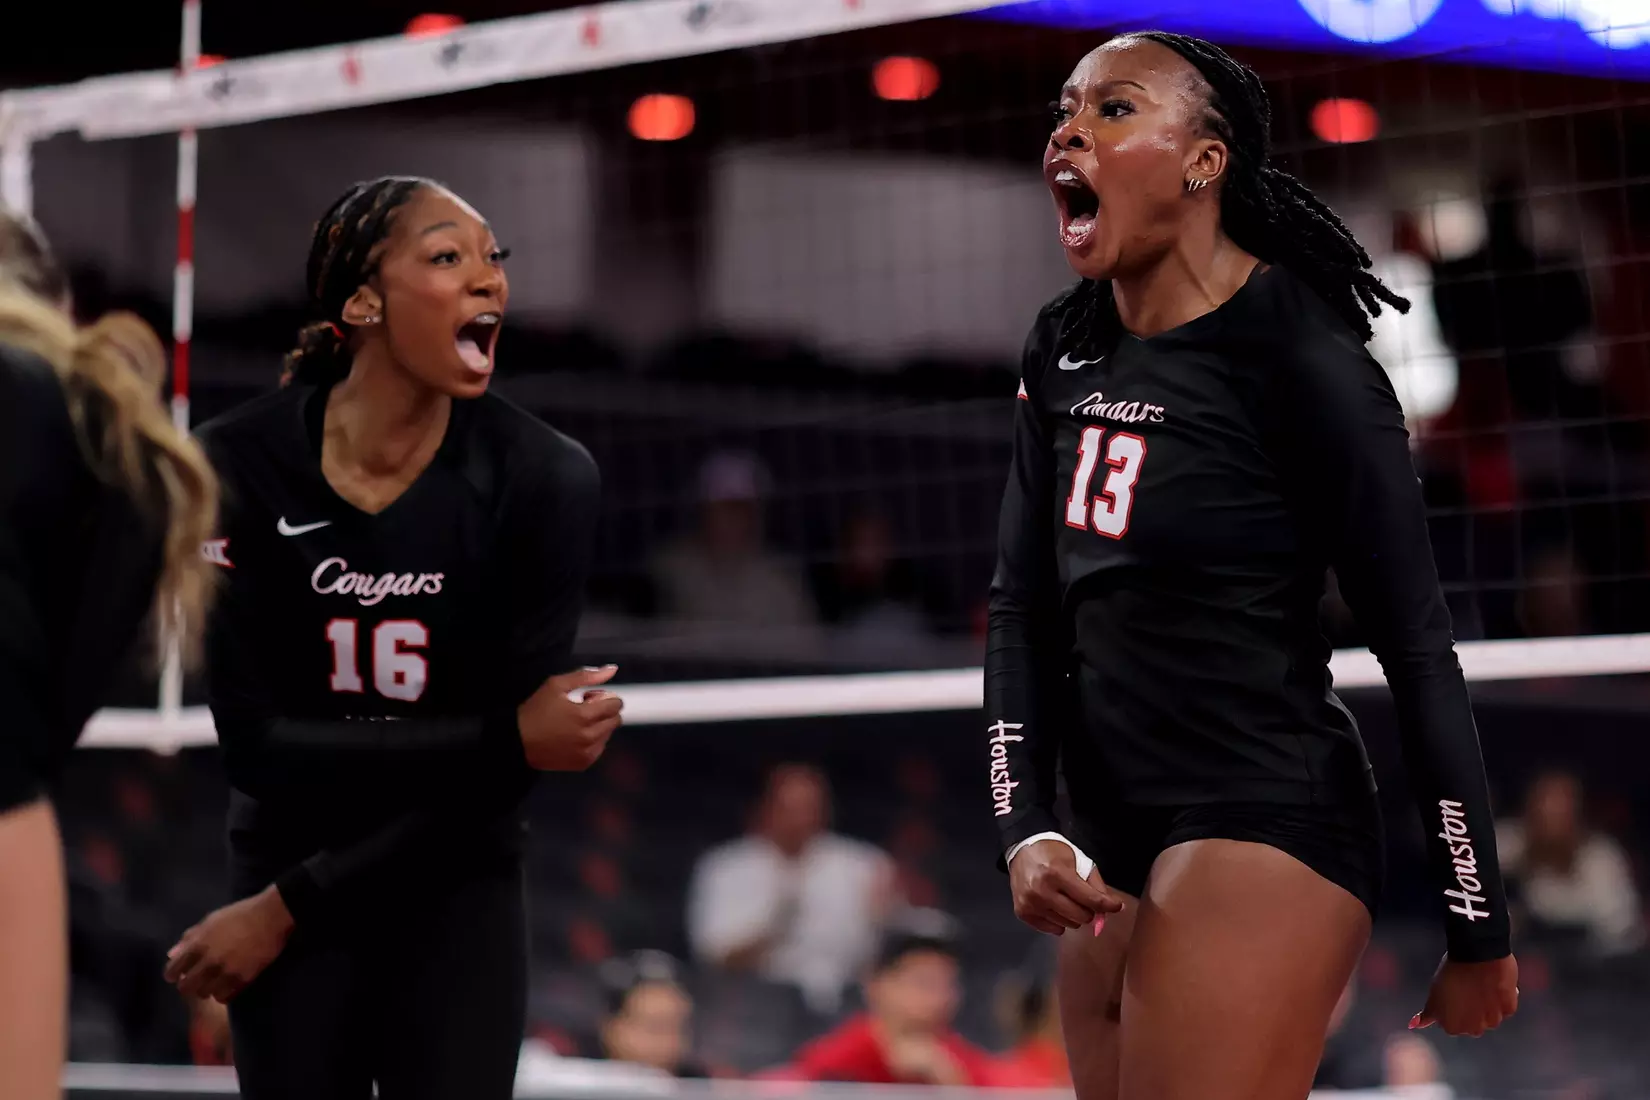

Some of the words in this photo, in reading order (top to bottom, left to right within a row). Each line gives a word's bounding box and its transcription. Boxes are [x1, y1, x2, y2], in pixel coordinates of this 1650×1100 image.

[1064, 424, 1148, 540] 13
[310, 556, 445, 606] Cougars
[325, 617, 430, 702] 16
[987, 719, 1025, 817] Houston
[1438, 799, 1490, 922] Houston
